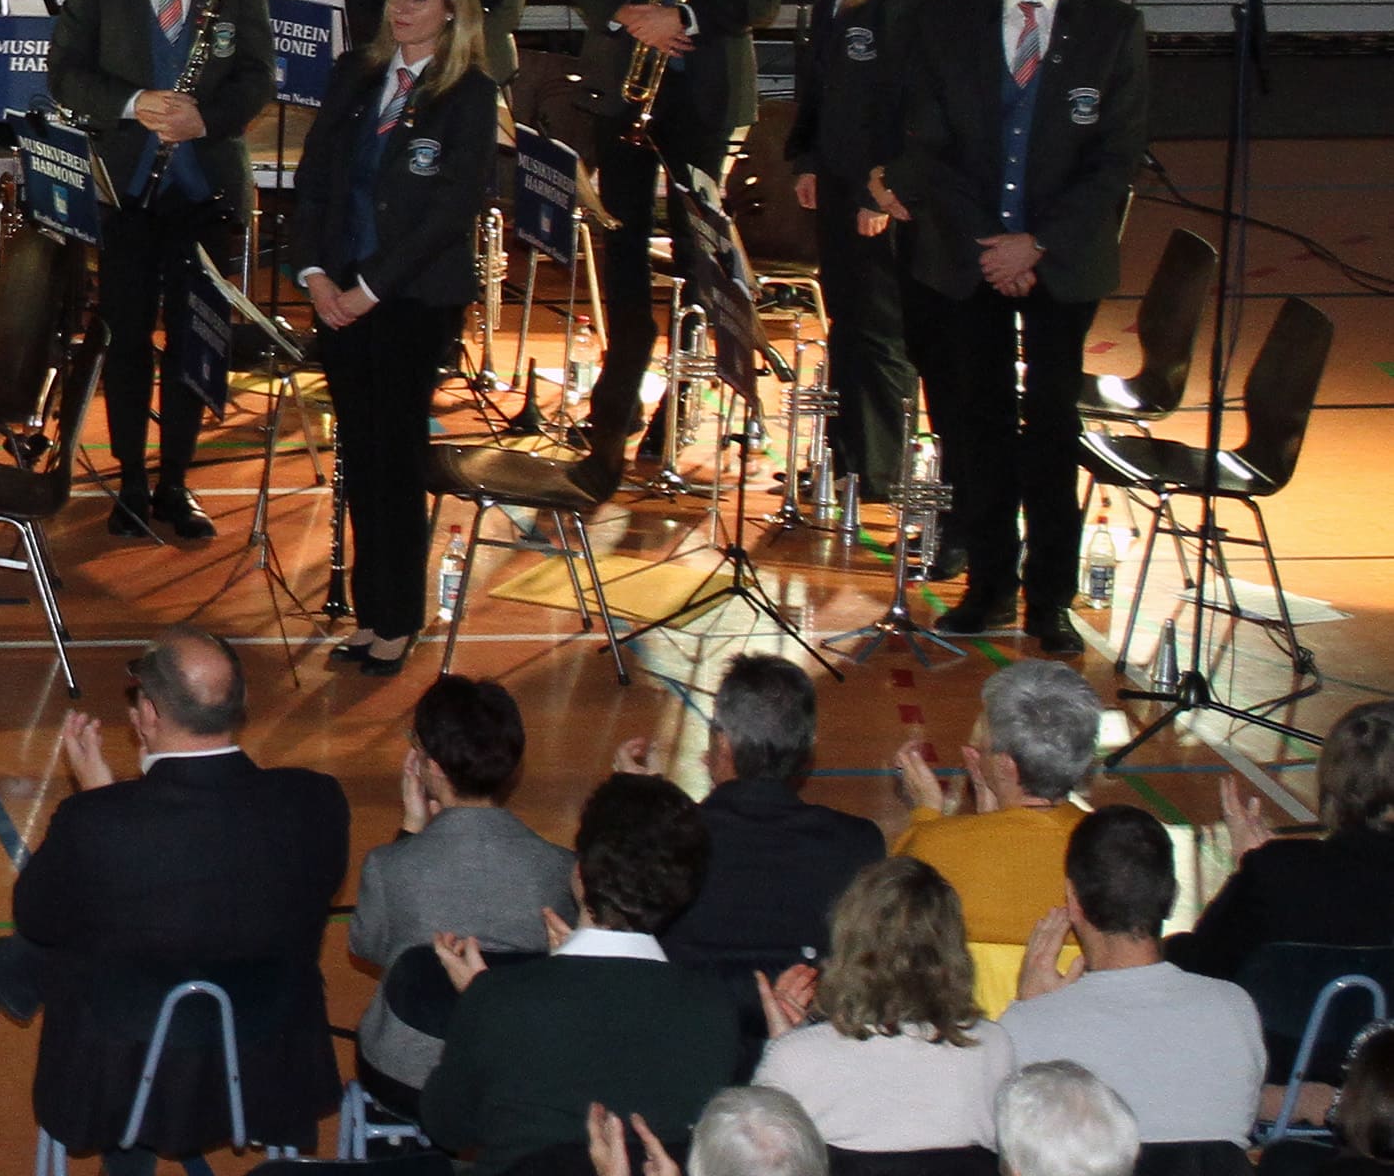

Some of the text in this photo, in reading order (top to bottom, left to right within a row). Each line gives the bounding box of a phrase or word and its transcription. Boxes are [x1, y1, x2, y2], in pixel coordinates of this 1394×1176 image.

[269, 18, 329, 42] VEREIN
[273, 37, 317, 58] ONIE
[31, 155, 85, 192] HARMONIE
